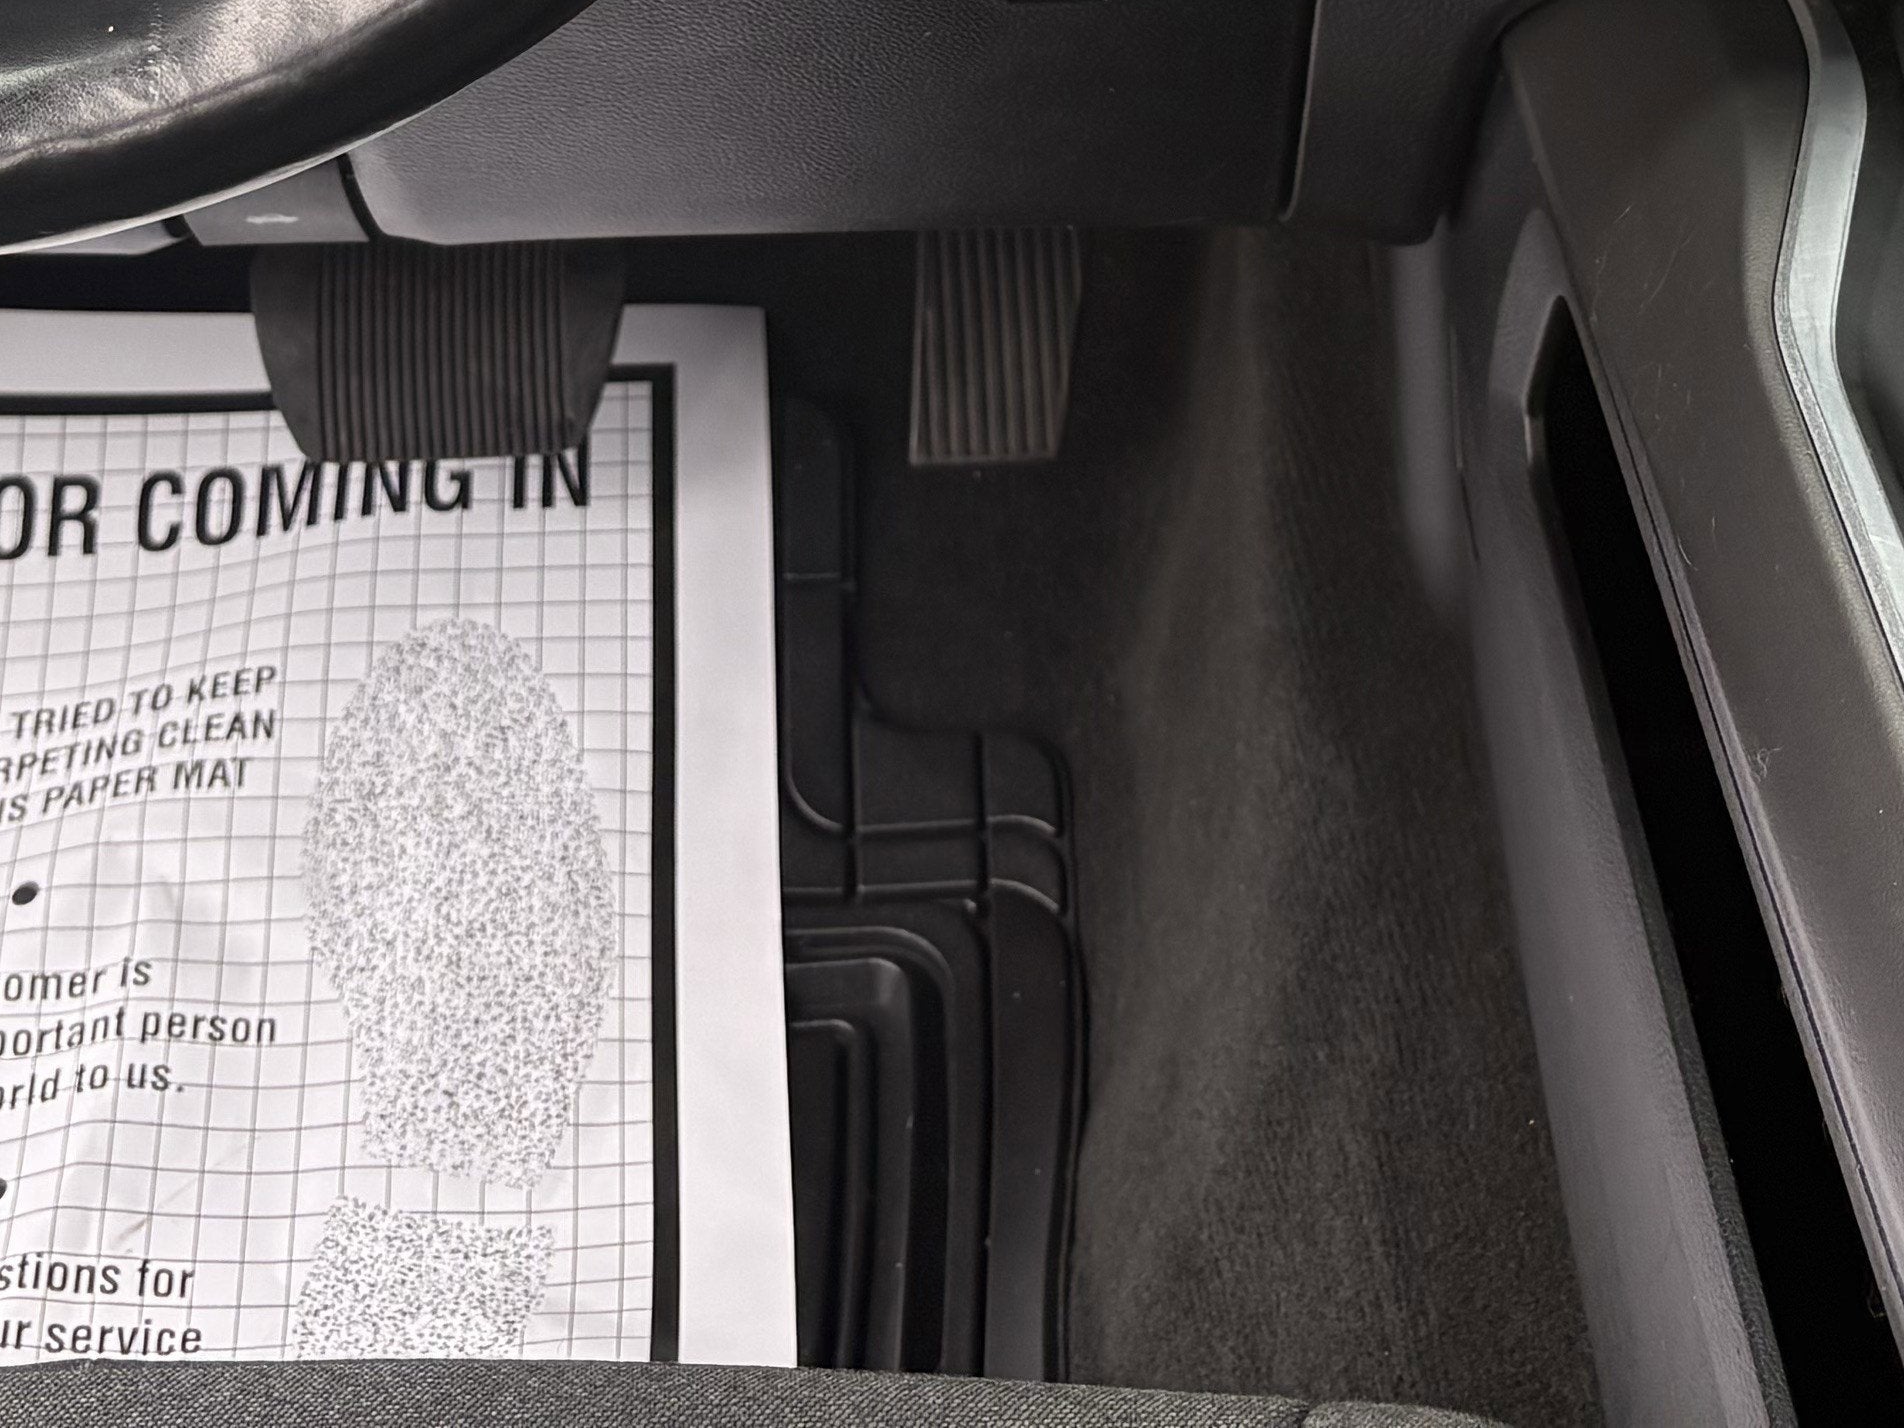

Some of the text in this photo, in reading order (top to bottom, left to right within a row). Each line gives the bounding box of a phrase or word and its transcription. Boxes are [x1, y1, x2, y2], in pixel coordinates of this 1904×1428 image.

[137, 458, 473, 552] COMING
[512, 440, 590, 508] IN
[12, 697, 116, 739] TRIED
[130, 683, 173, 715] TO
[187, 665, 276, 704] KEEP
[158, 710, 276, 748] CLEAN
[42, 764, 156, 814] PAPER
[173, 756, 253, 791] MAT
[120, 956, 153, 987] is
[140, 1011, 277, 1045] person
[75, 1063, 108, 1093] to
[127, 1061, 185, 1093] us.
[138, 1258, 195, 1298] for
[45, 1318, 202, 1355] service
